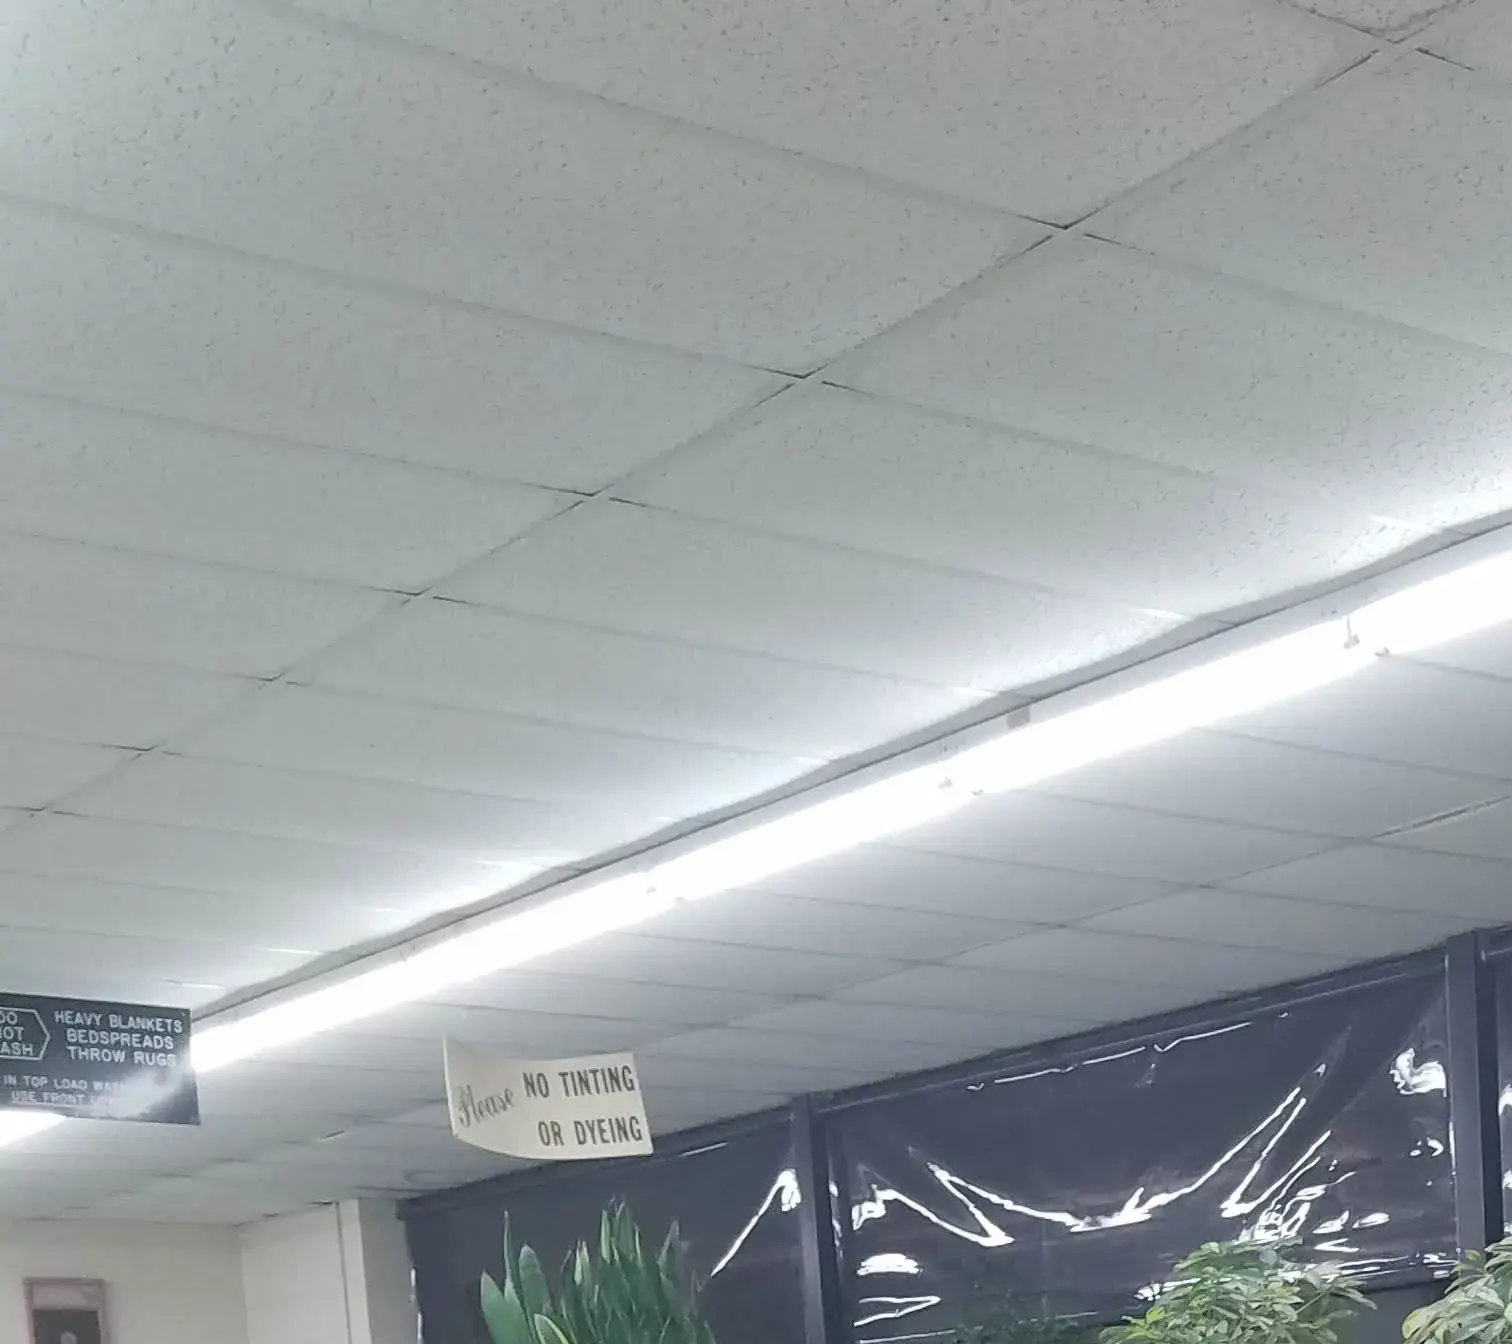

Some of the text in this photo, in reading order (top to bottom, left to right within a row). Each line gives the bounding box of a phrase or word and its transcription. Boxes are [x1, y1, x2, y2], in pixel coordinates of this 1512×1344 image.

[54, 1010, 183, 1034] HEAVY BLANKETS
[66, 1028, 175, 1050] BEDSPREADS
[66, 1046, 177, 1068] THROW RUGS
[23, 1075, 48, 1087] TOP
[54, 1079, 88, 1091] LOAD
[522, 1065, 636, 1099] NO TINTING
[457, 1085, 518, 1128] Please
[537, 1116, 644, 1147] OR DYEING
